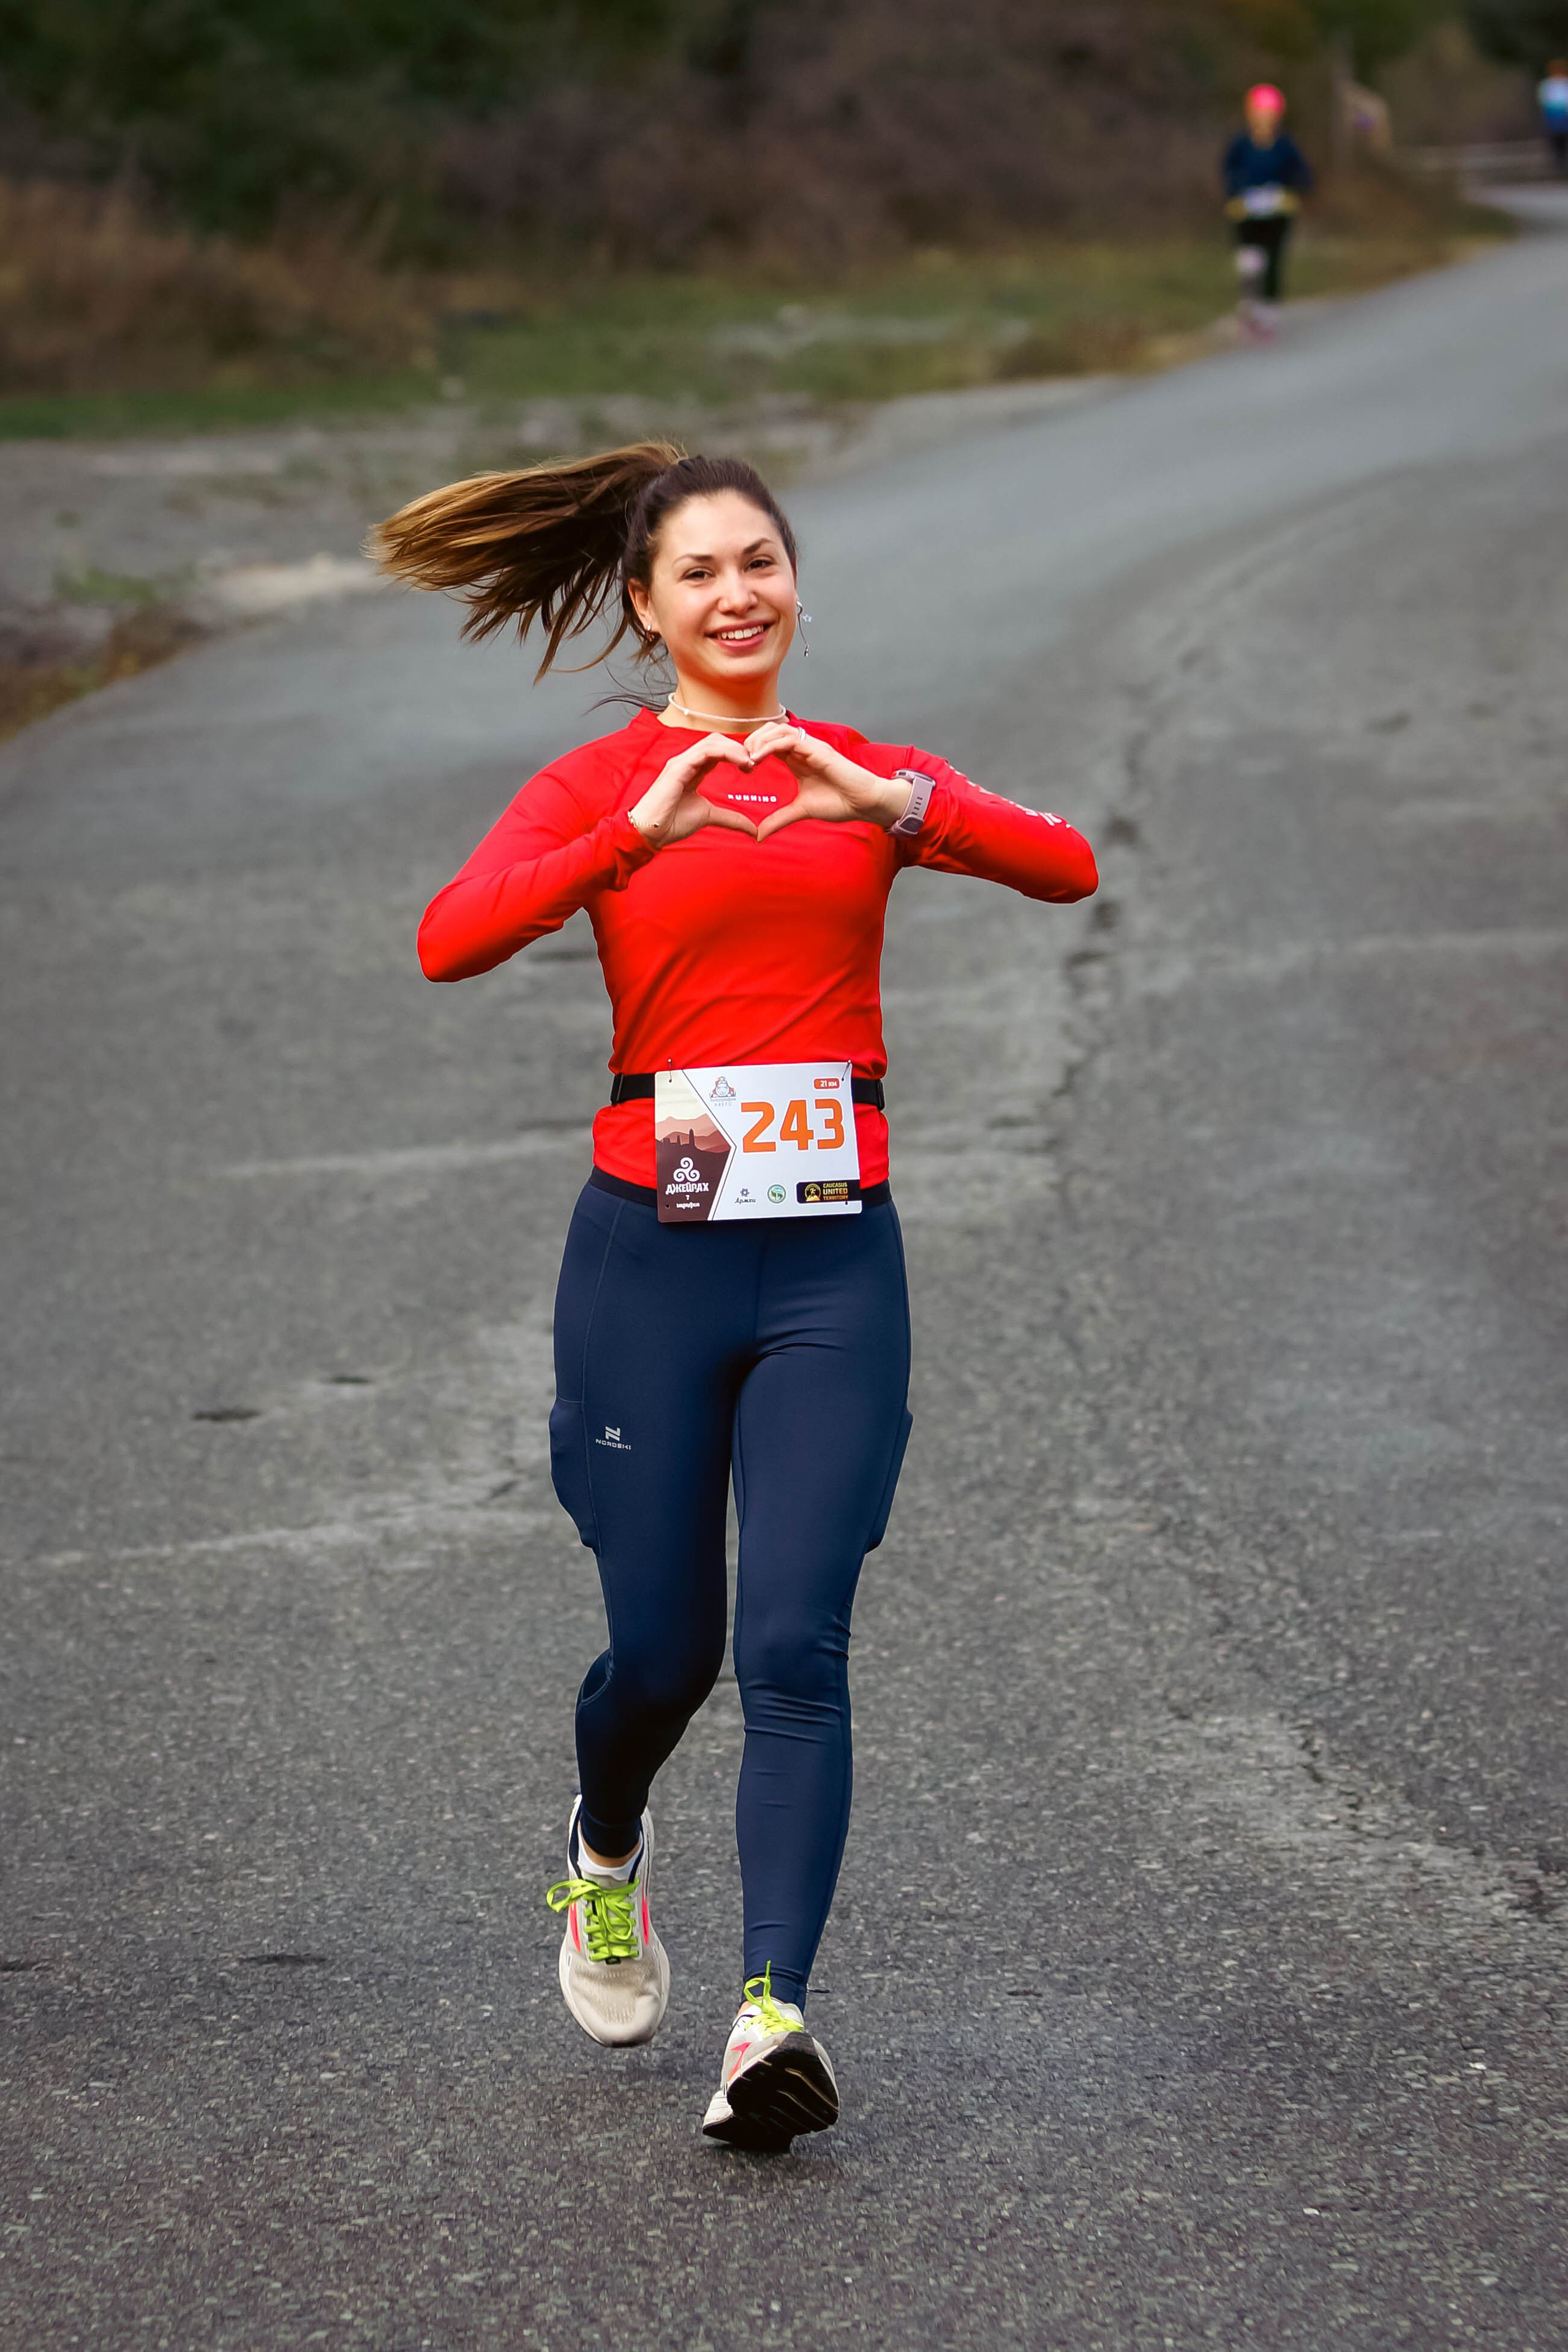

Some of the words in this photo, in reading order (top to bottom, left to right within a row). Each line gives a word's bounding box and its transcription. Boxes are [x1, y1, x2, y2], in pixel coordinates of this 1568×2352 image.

[728, 794, 777, 802] RUNNING
[741, 1098, 845, 1153] 243
[665, 1182, 709, 1195] ДЖЕЙРАХ
[595, 1439, 631, 1450] NORDSKI
